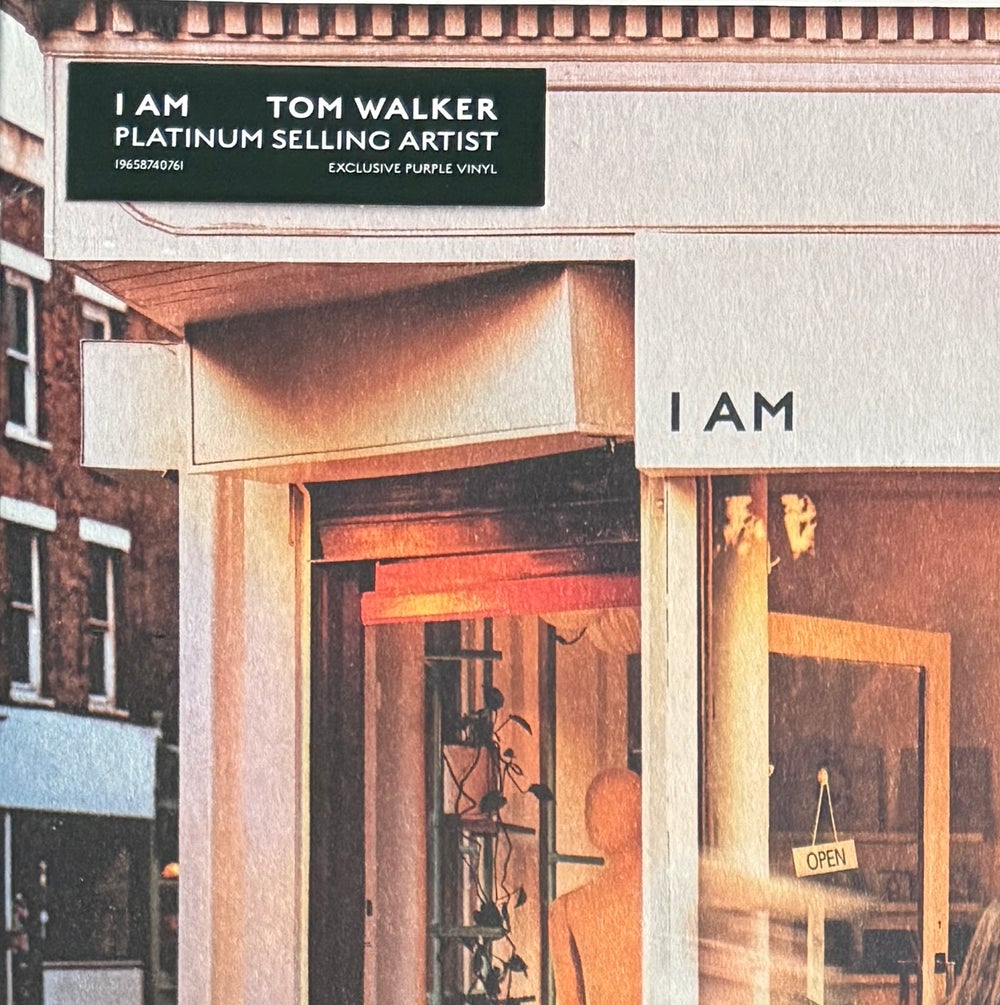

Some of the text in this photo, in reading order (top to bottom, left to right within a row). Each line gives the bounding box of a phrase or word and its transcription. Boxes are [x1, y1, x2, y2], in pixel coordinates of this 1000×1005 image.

[115, 92, 189, 117] I AM
[265, 95, 499, 121] TOM WALKER
[115, 126, 499, 152] PLATINUM SELLING ARTIST
[114, 159, 184, 171] 19658740761
[328, 162, 498, 175] EXCLUSIVE PURPLE VINYL
[671, 391, 795, 432] I AM
[806, 847, 847, 871] OPEN
